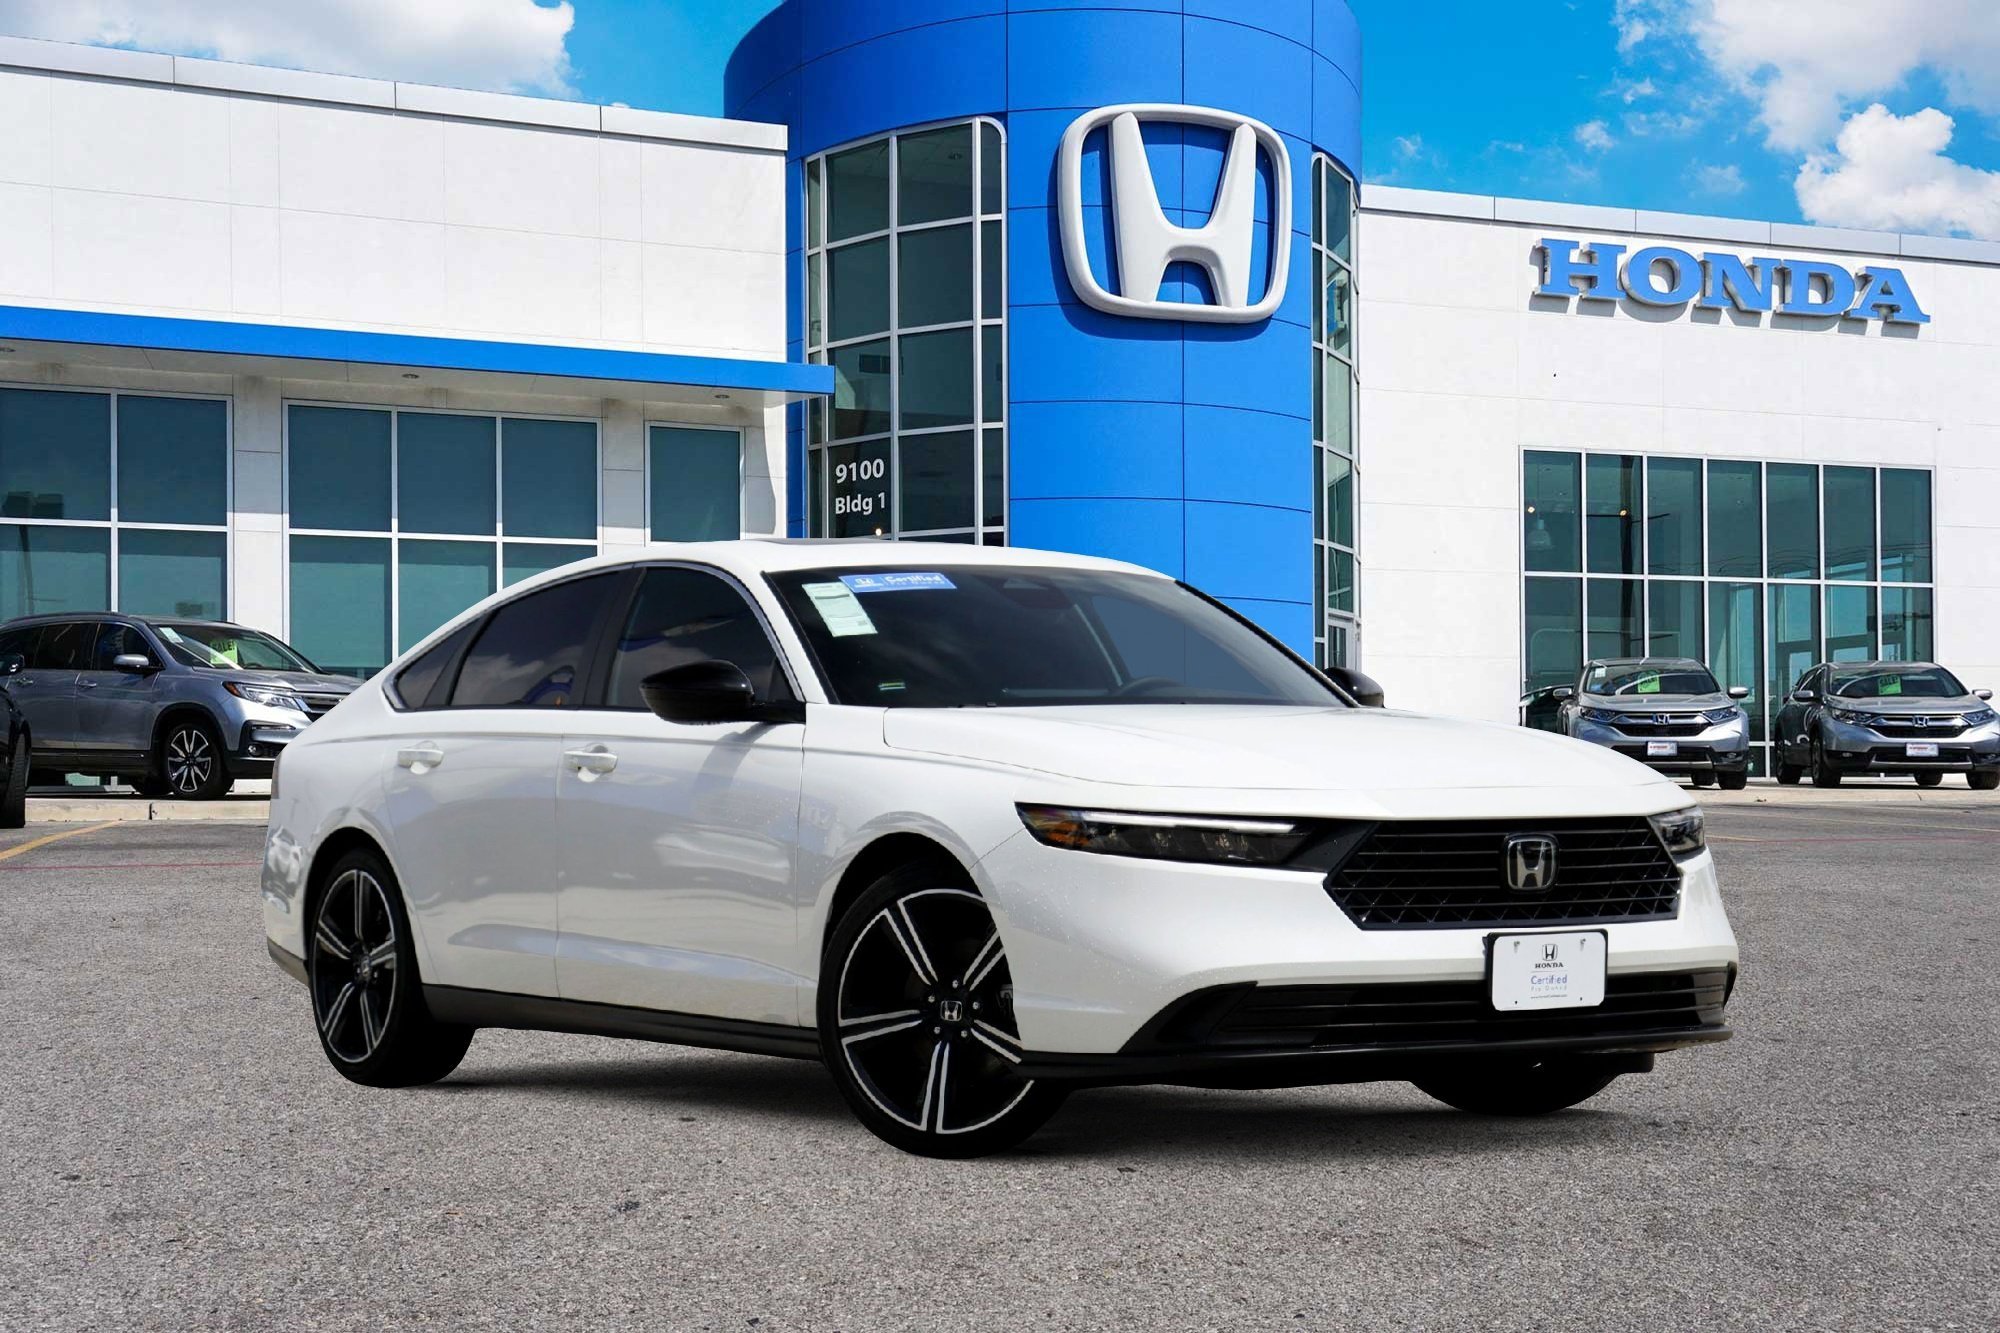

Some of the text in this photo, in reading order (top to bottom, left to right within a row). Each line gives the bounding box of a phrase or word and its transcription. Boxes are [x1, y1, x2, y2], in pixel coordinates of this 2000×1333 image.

[1535, 238, 1931, 323] HONDA
[835, 458, 885, 484] 9100
[835, 491, 886, 515] Bldg 1
[1530, 974, 1568, 985] Certified
